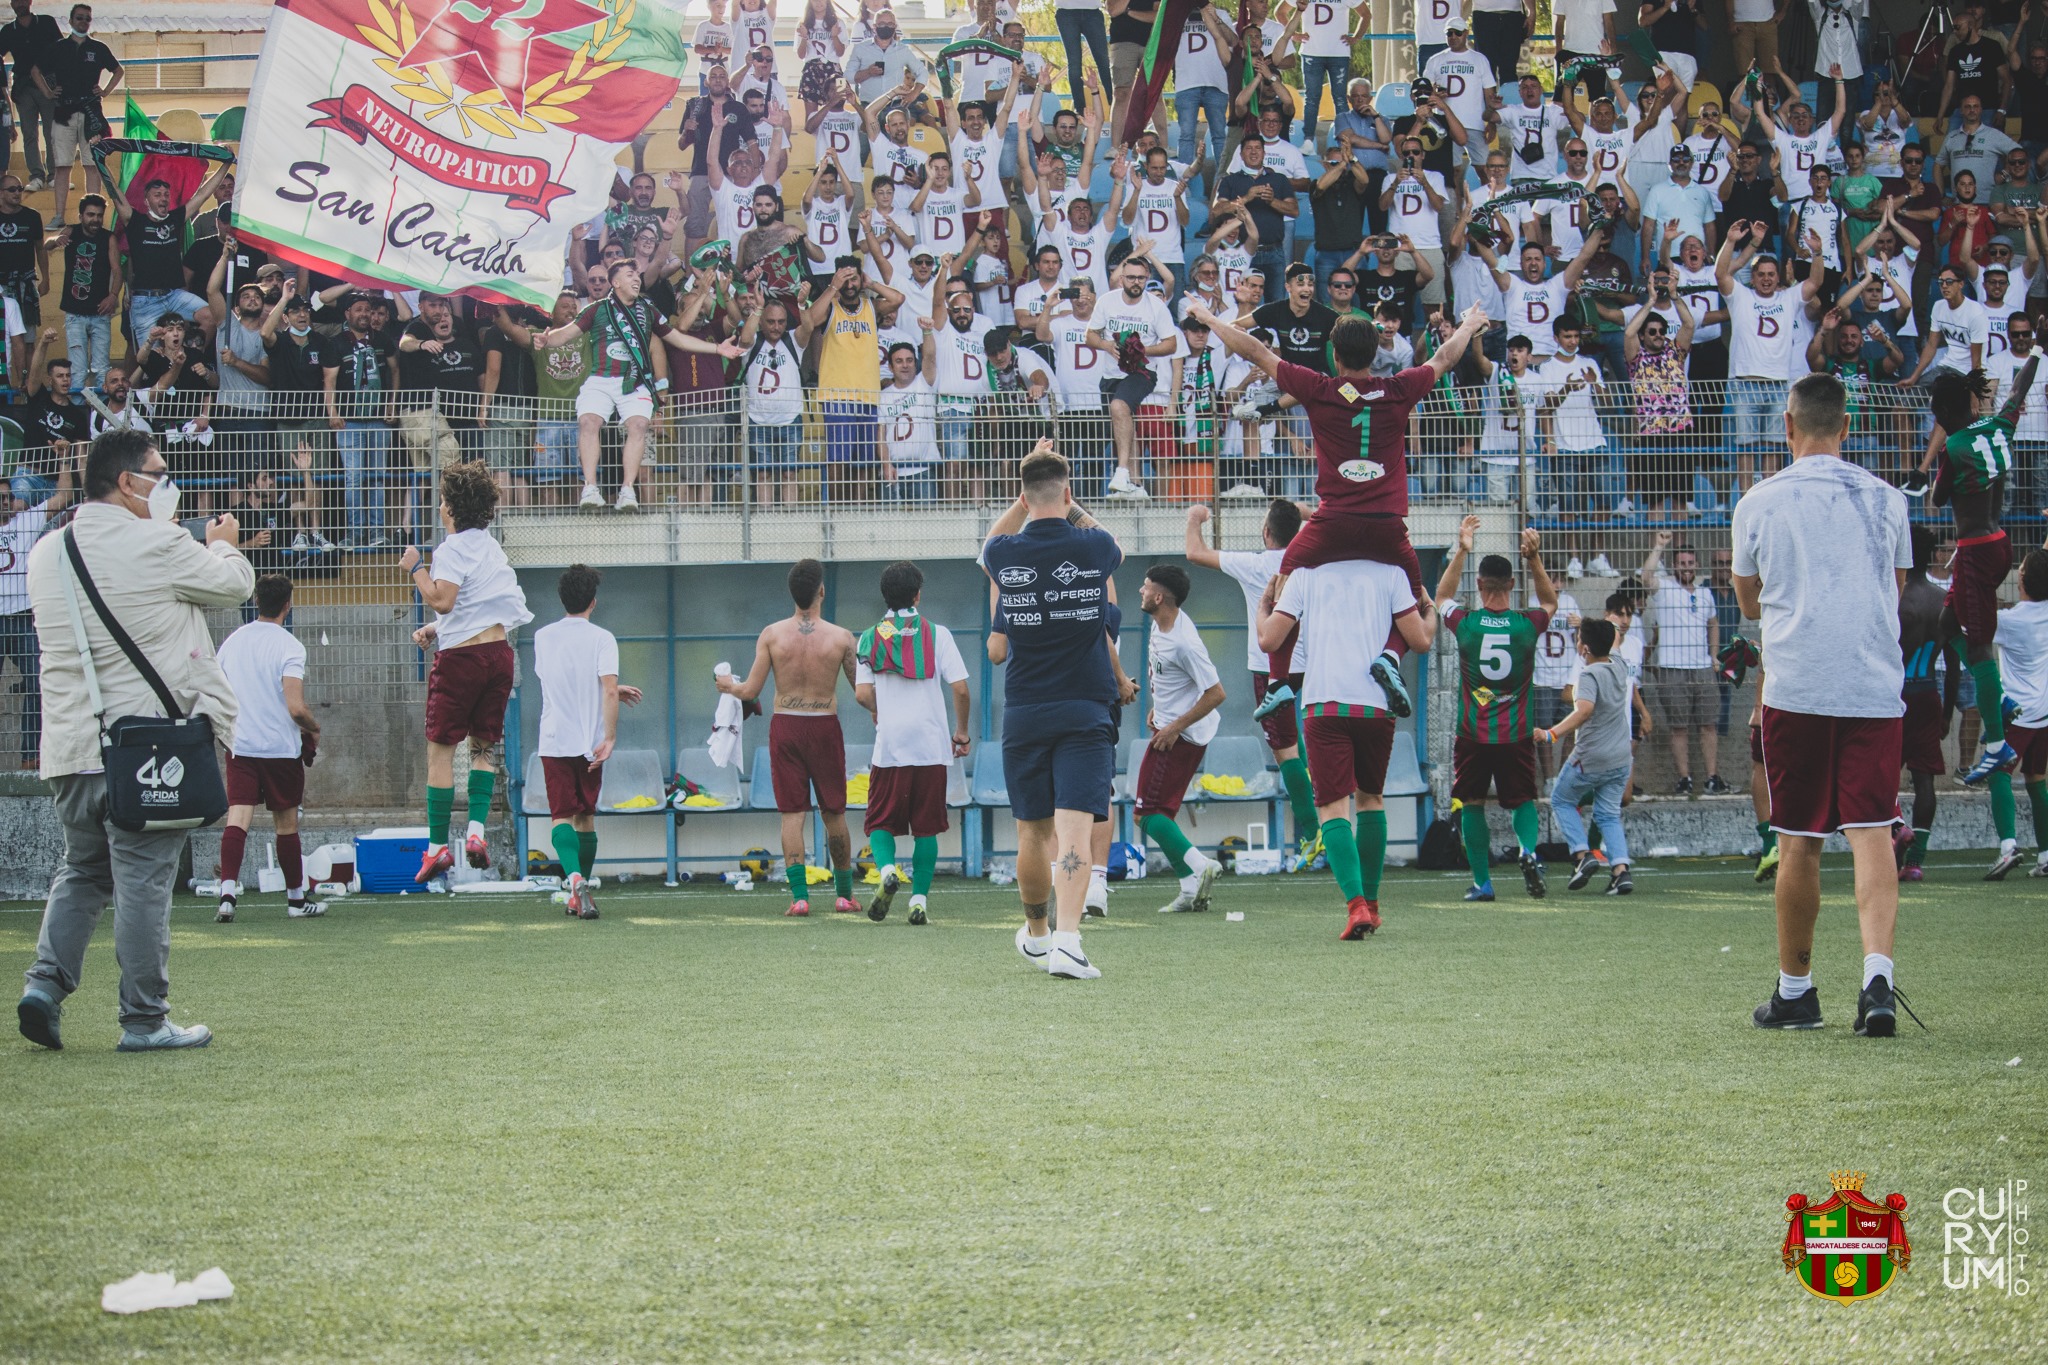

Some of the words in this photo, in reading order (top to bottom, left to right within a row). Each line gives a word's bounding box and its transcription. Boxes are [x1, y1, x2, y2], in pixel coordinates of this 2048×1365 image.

[1315, 4, 1333, 25] D
[1188, 33, 1207, 54] D
[1447, 75, 1466, 97] D
[1959, 71, 1982, 79] adidas
[356, 97, 537, 188] NEUROPATICO
[830, 131, 850, 153] D
[275, 160, 375, 226] San
[1402, 194, 1422, 217] D
[934, 216, 954, 240] D
[1148, 209, 1169, 232] D
[1527, 301, 1550, 324] D
[963, 353, 983, 380] D
[1074, 344, 1098, 370] D
[1351, 405, 1372, 458] 1
[1971, 428, 2012, 479] 11
[1002, 596, 1037, 605] MENNA
[1060, 587, 1101, 601] FERRO
[1012, 612, 1042, 622] ZODA
[1545, 631, 1566, 658] D
[1479, 633, 1513, 681] 5
[780, 694, 833, 710] Libertad
[153, 790, 179, 799] FIDAS
